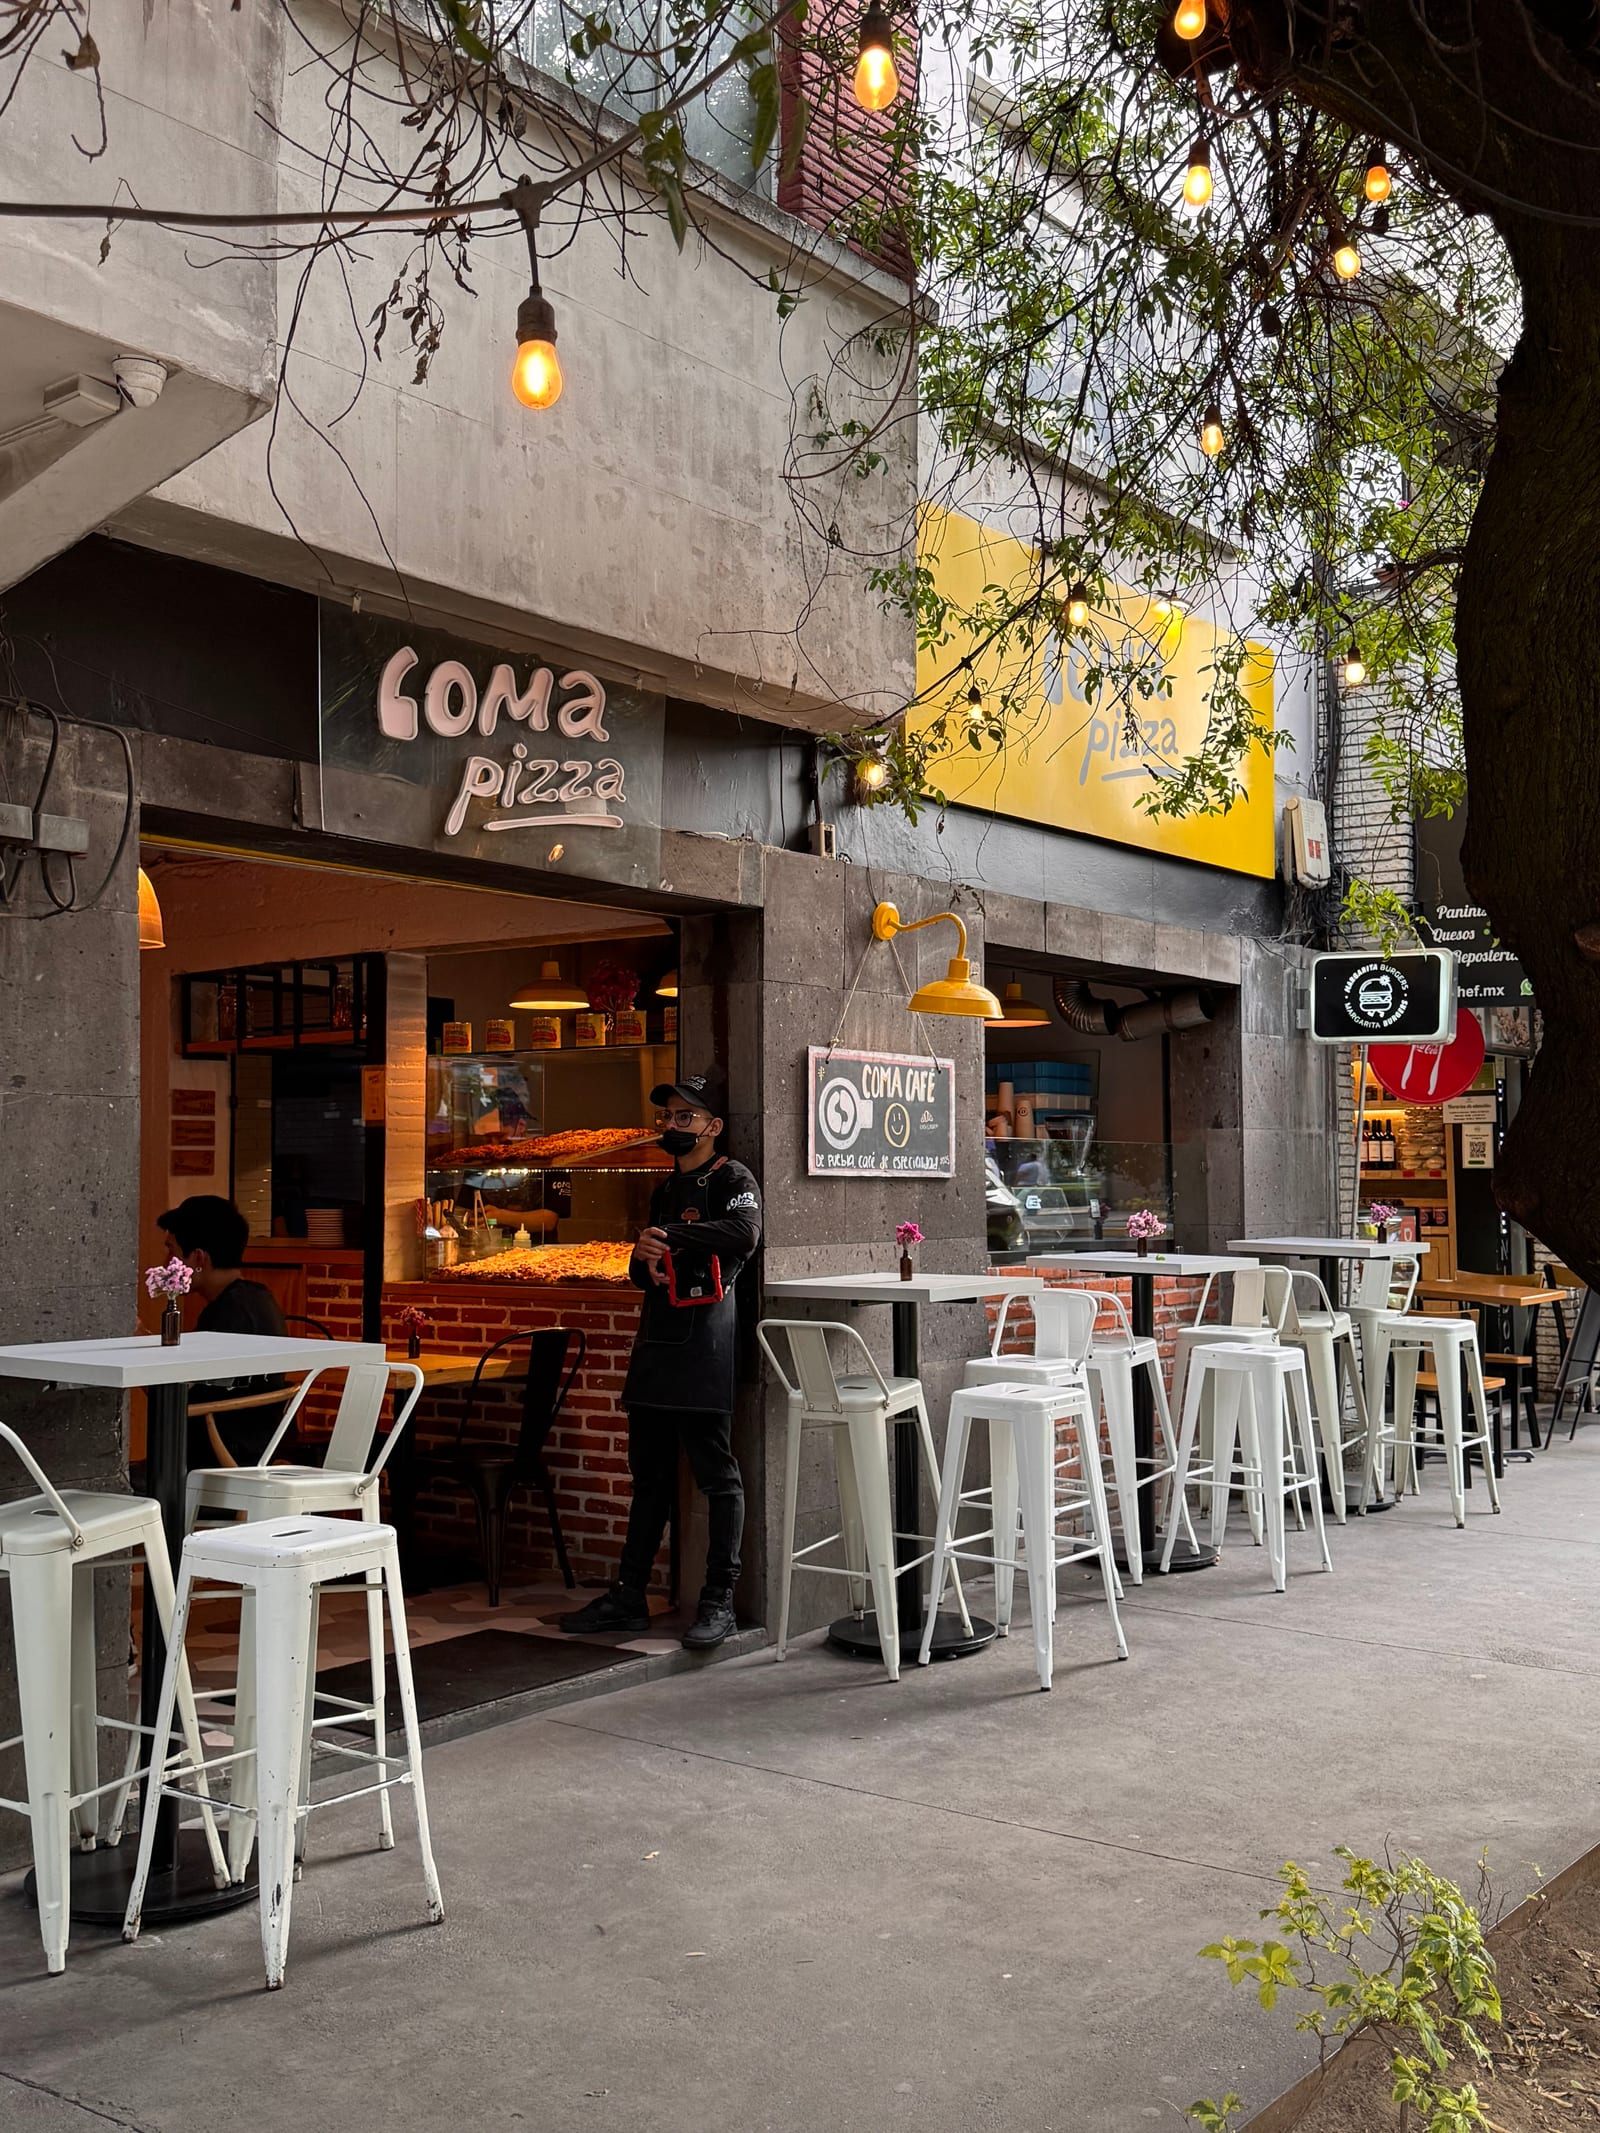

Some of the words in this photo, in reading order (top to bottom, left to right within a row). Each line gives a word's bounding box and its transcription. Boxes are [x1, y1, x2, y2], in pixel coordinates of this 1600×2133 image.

[1080, 708, 1179, 786] pizza
[444, 743, 627, 836] pizza
[1432, 928, 1476, 944] Quesos
[1344, 963, 1378, 993] MARGARITA
[1380, 963, 1409, 991] BURGERS
[1344, 1002, 1381, 1029] MARGARITA
[1382, 1000, 1408, 1028] BURGERS
[862, 1064, 903, 1099] COMA
[905, 1069, 936, 1103] CAFÉ
[858, 1151, 876, 1169] café
[879, 1154, 889, 1170] de
